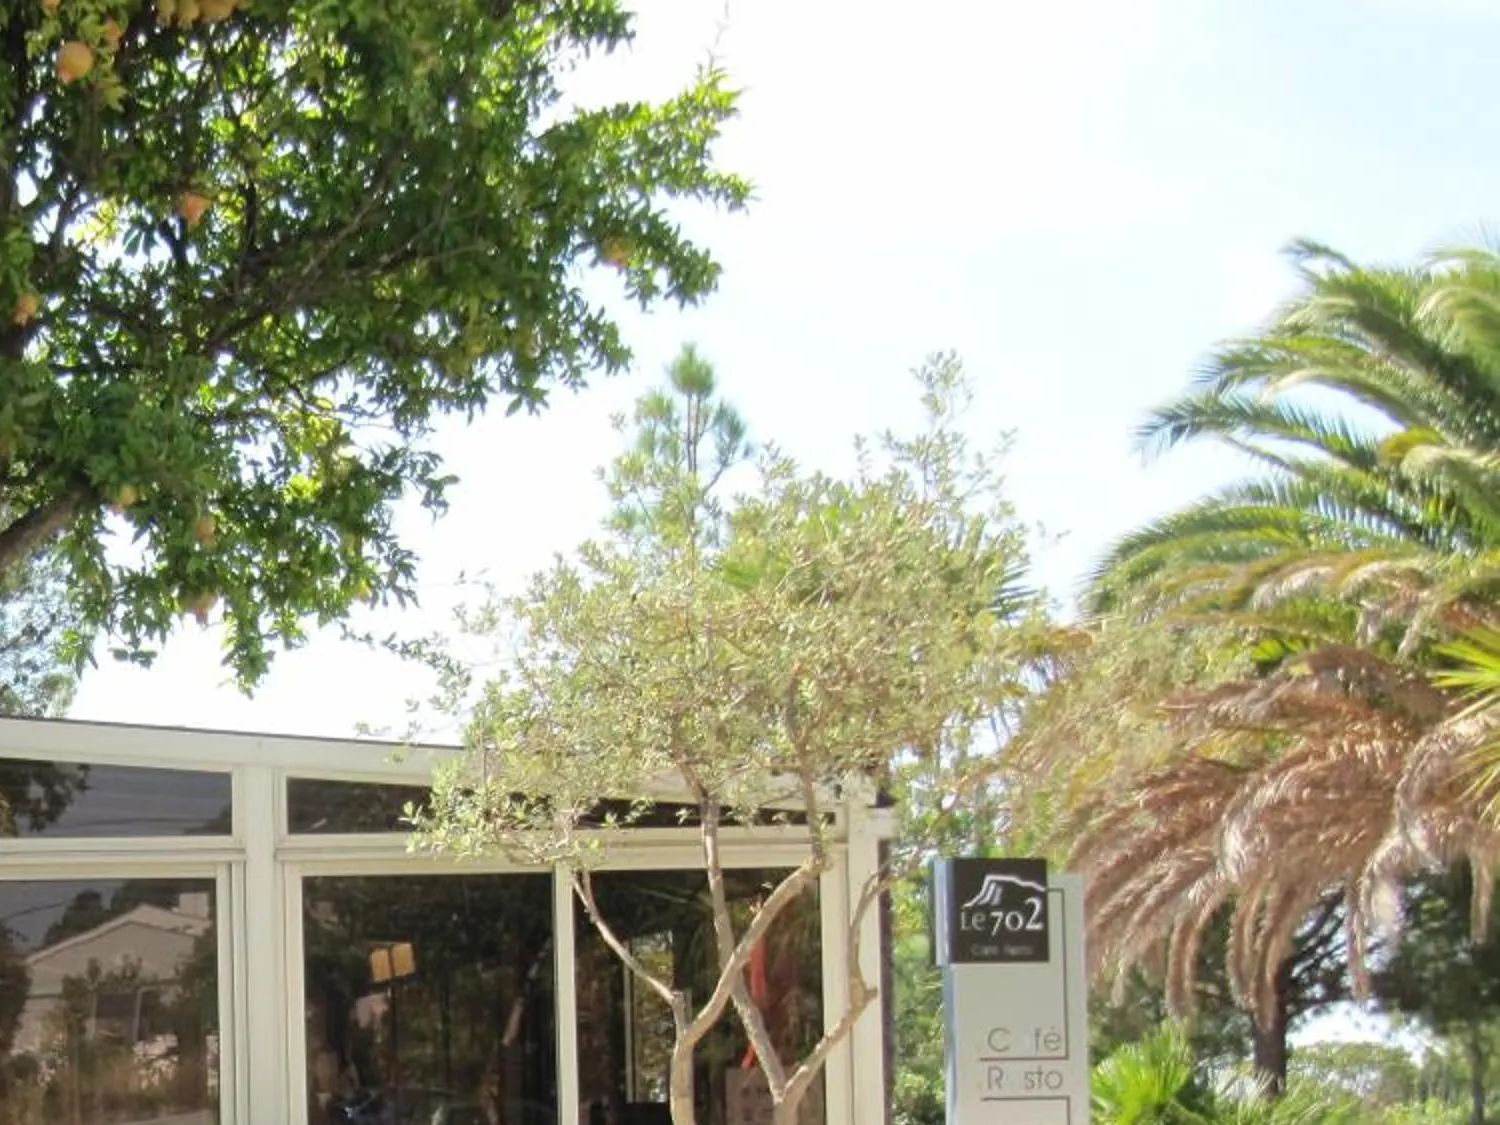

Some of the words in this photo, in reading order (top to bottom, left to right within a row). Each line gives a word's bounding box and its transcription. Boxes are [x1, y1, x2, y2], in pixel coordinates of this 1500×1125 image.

[960, 911, 986, 931] Le
[990, 897, 1044, 937] 702
[987, 1025, 1062, 1054] Cfé
[987, 1065, 1064, 1091] Rsto
